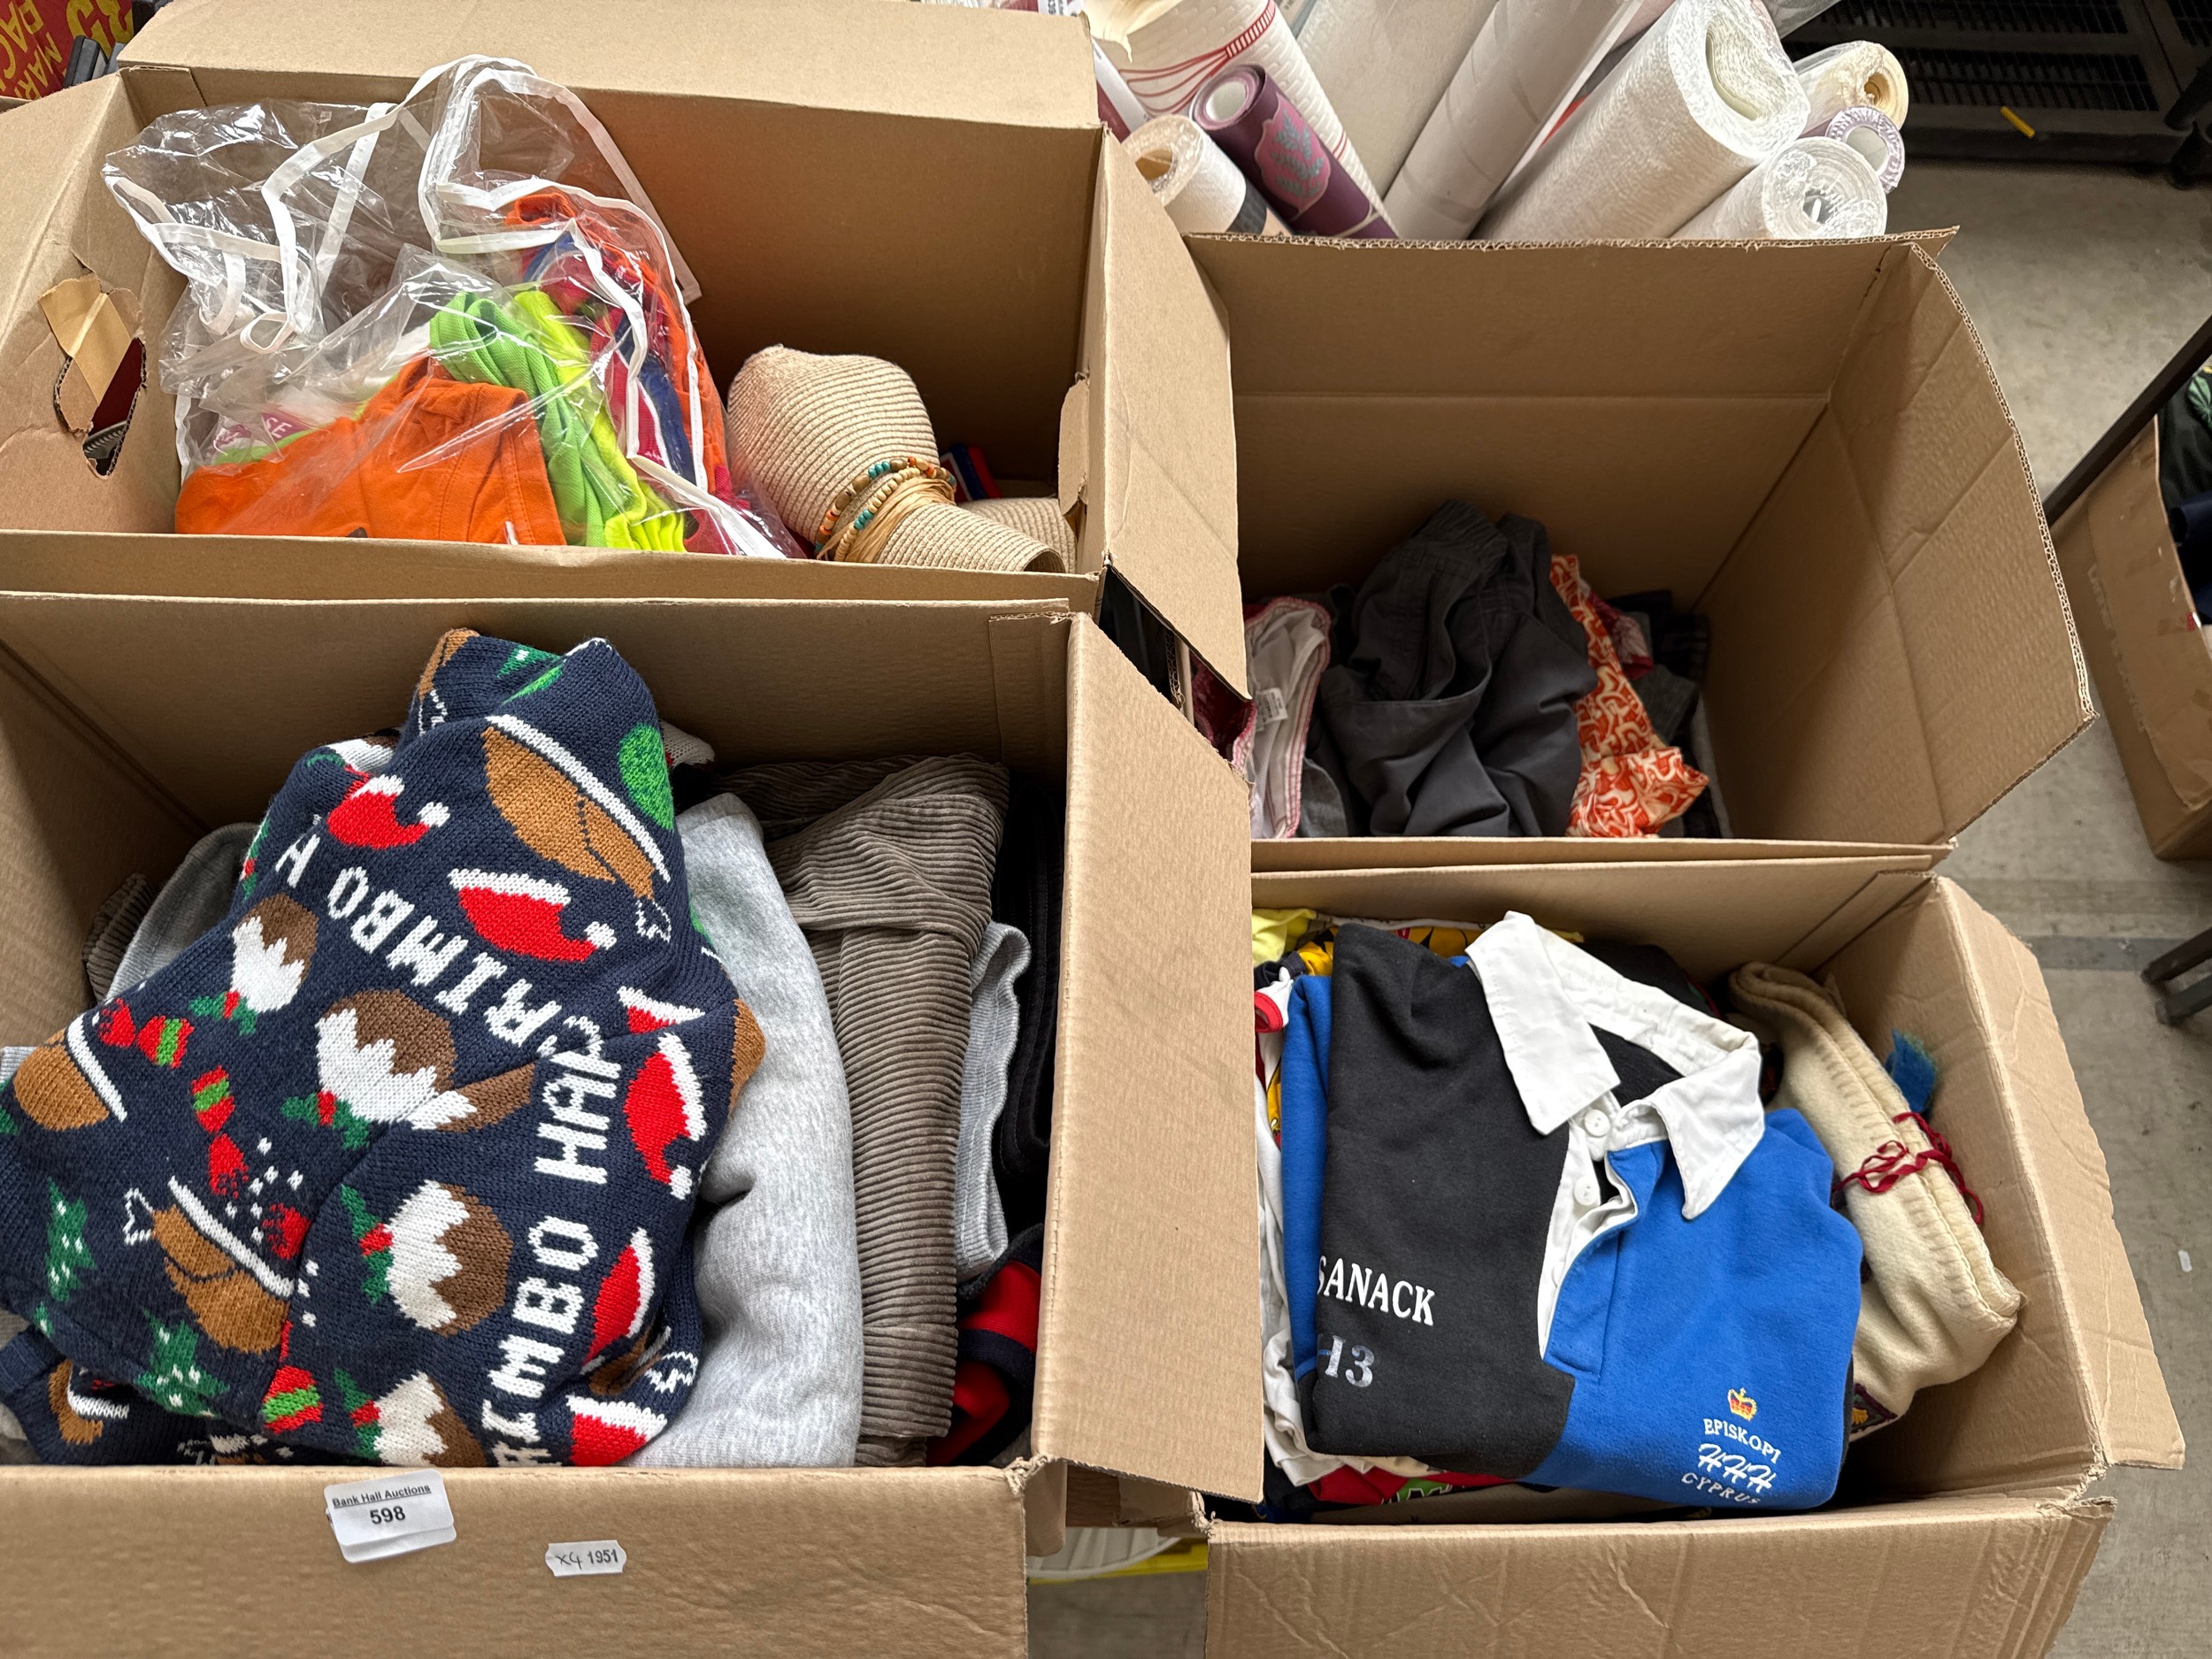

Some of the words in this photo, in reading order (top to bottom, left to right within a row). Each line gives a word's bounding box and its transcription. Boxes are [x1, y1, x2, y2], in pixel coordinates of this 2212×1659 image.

[1702, 1417, 1781, 1464] EPISKOPI
[332, 1494, 360, 1508] Bank
[361, 1491, 382, 1503] Hall
[385, 1484, 431, 1499] Auctions
[1681, 1472, 1761, 1504] CYPRUS
[370, 1505, 406, 1525] 598
[588, 1548, 618, 1564] 1951
